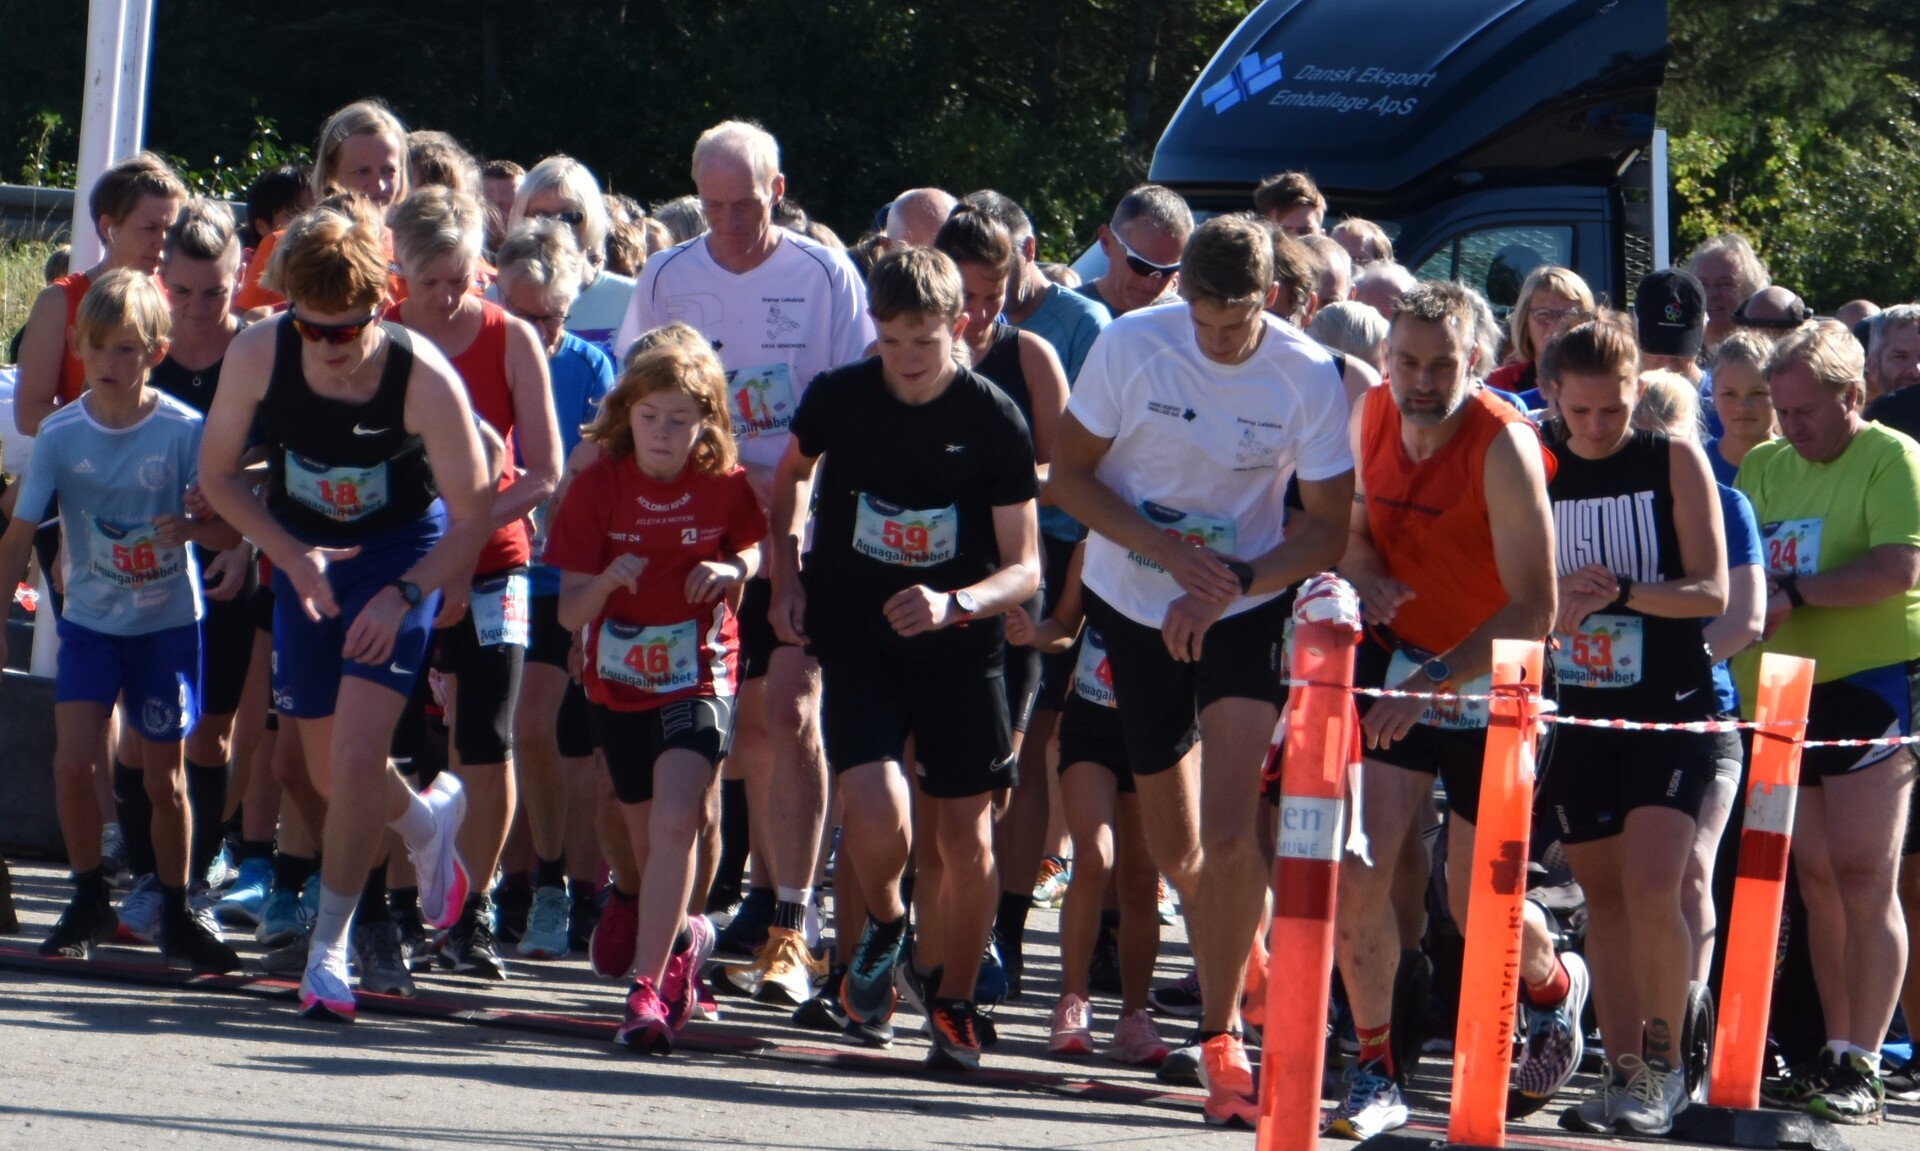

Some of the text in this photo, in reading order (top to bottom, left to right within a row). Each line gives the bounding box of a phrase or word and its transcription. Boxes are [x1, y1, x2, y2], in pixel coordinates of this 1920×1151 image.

[1294, 64, 1438, 88] Dansk Eksport
[1268, 90, 1418, 117] Emballage ApS
[316, 479, 357, 506] 18
[636, 495, 670, 512] KOLDING
[881, 519, 929, 552] 59
[112, 542, 157, 573] 56
[856, 537, 912, 563] Aquagain
[1127, 550, 1166, 574] Aquag
[1769, 536, 1798, 569] 24
[623, 642, 669, 674] 46
[1571, 632, 1612, 667] 53
[600, 665, 654, 688] Aquagain
[1666, 769, 1683, 797] FUSION
[1283, 806, 1322, 831] en
[1555, 804, 1571, 834] FUSION
